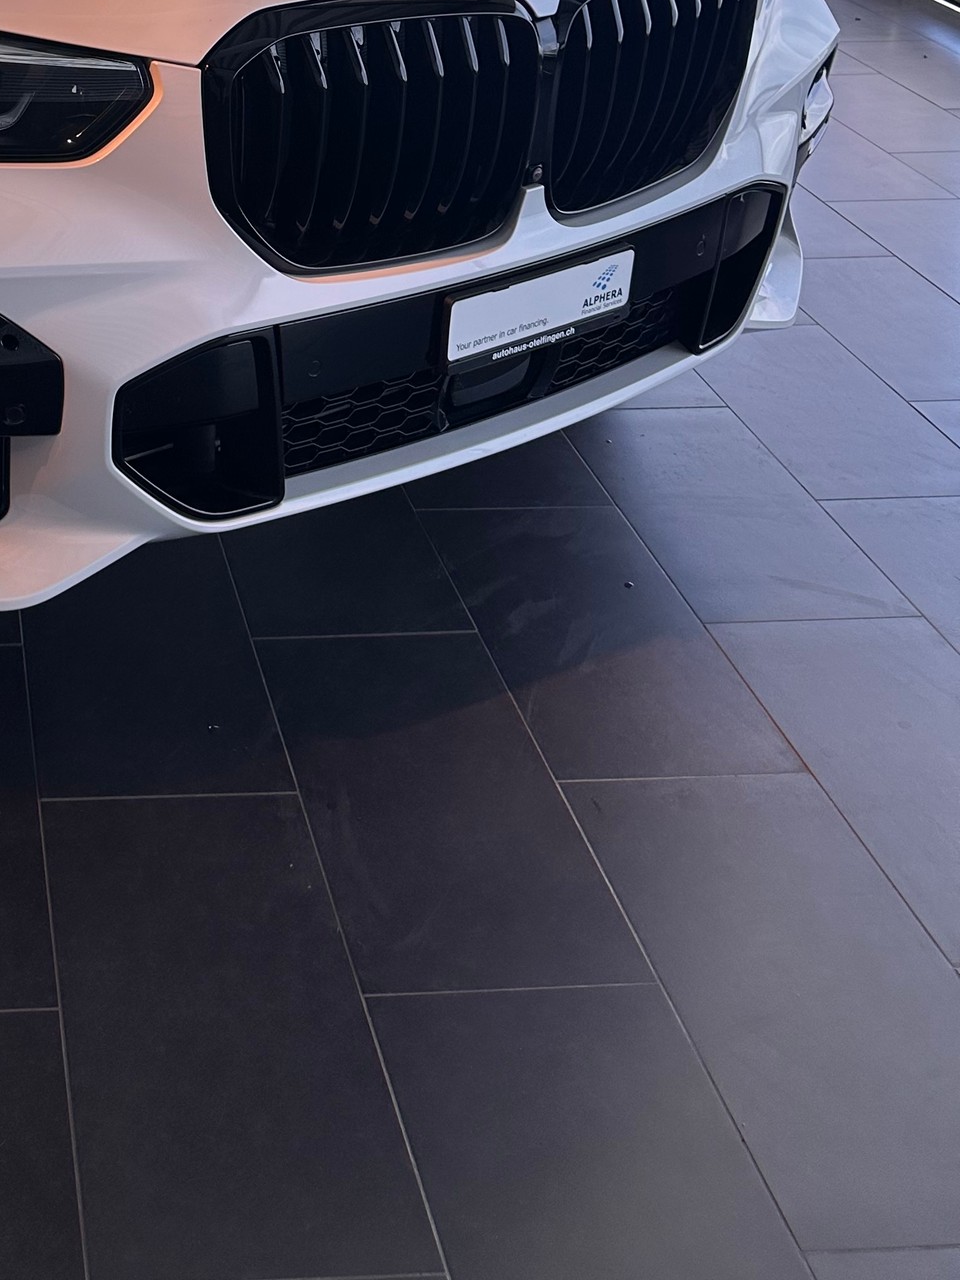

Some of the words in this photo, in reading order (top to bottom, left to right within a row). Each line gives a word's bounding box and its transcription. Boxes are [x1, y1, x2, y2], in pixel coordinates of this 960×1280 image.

[581, 304, 602, 316] Financial
[603, 298, 623, 308] Services
[582, 288, 623, 308] ALPHERA
[456, 341, 473, 352] Your
[473, 333, 498, 348] partner
[498, 330, 506, 339] in
[506, 327, 518, 336] car
[518, 317, 549, 332] financing.
[492, 327, 576, 360] autohaus-otelfingen.ch
